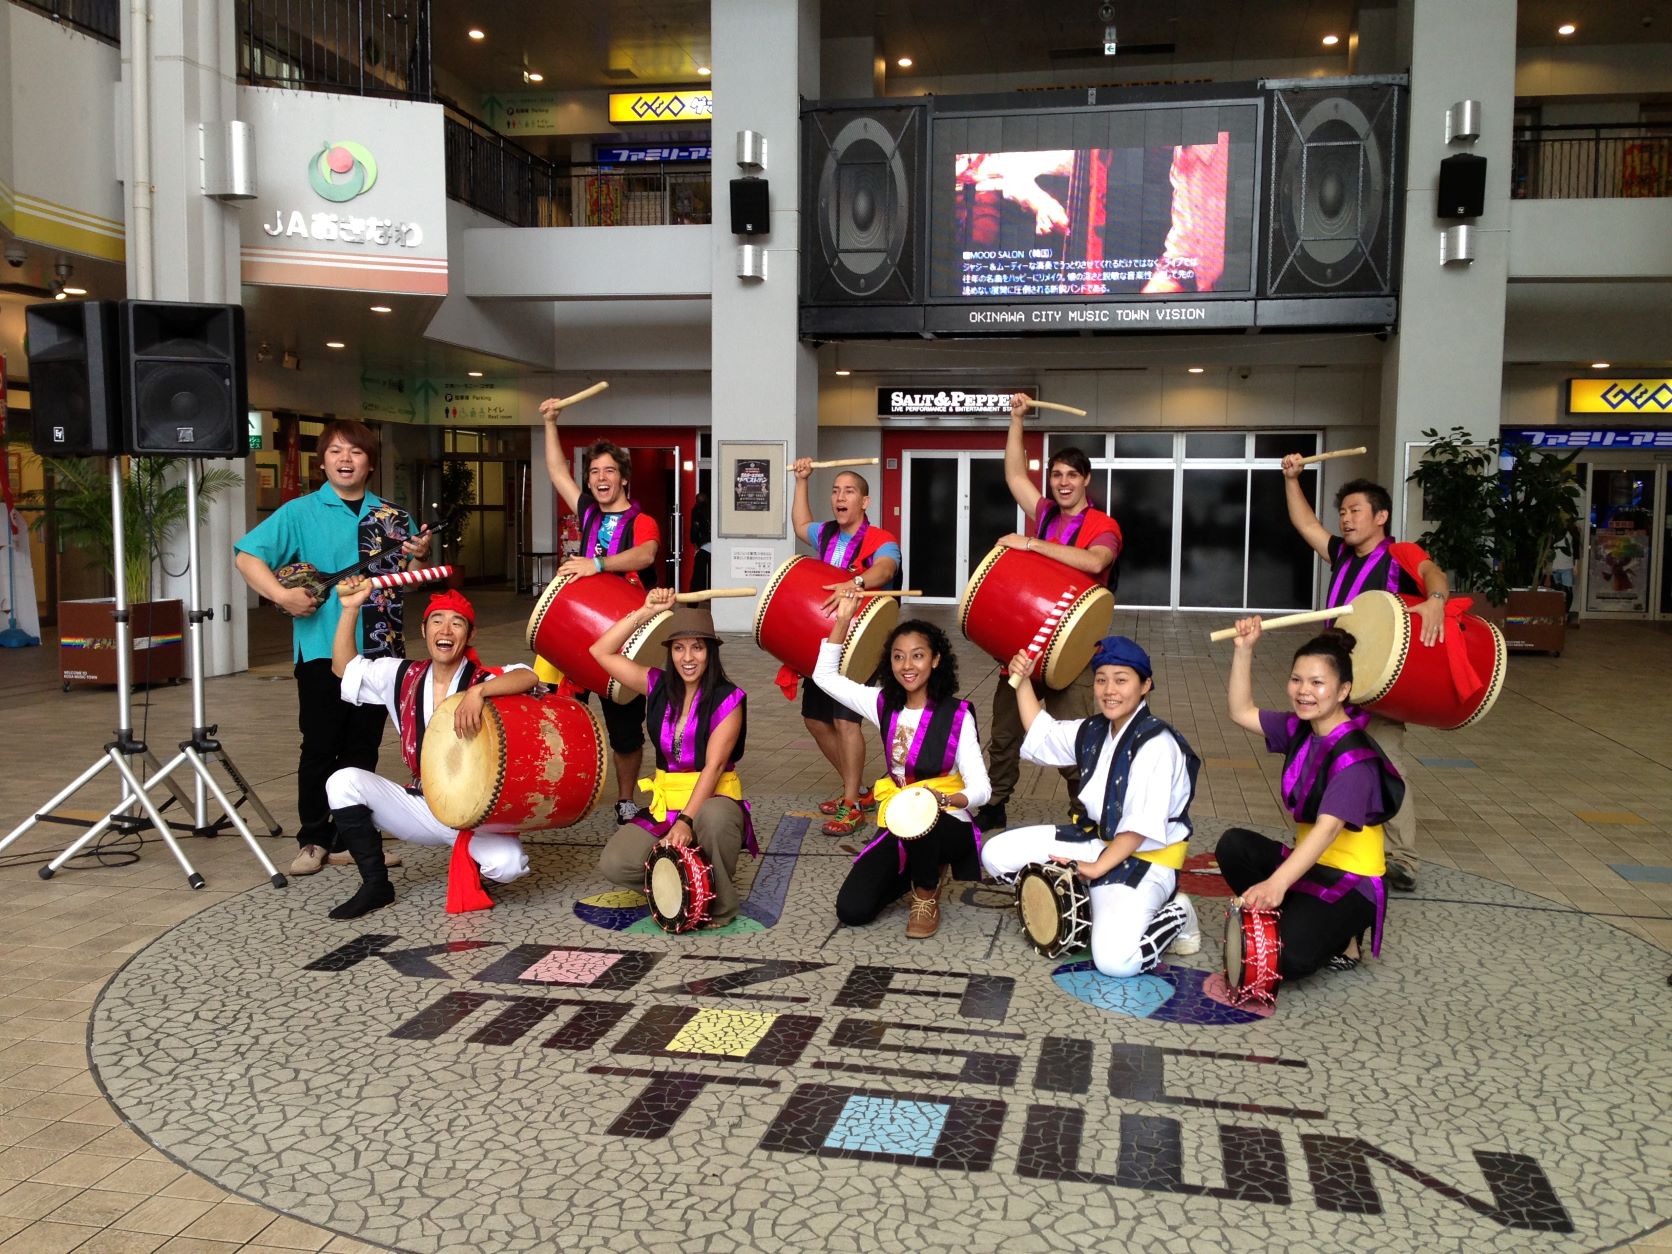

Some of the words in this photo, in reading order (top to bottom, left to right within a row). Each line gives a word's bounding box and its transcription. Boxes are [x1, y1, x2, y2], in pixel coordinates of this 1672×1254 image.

[631, 95, 686, 118] GEO
[263, 210, 424, 248] JAおきなわ
[998, 250, 1025, 259] SALON
[969, 311, 1025, 323] OKINAWA
[1032, 311, 1062, 322] CITY
[1068, 310, 1110, 322] MUSIC
[1116, 309, 1150, 321] TOWN
[1156, 308, 1205, 321] VISION
[1600, 382, 1672, 410] GEO
[303, 933, 1016, 1020] KOZA
[386, 991, 1328, 1120] MUSIC
[586, 1065, 1576, 1234] TOWN
